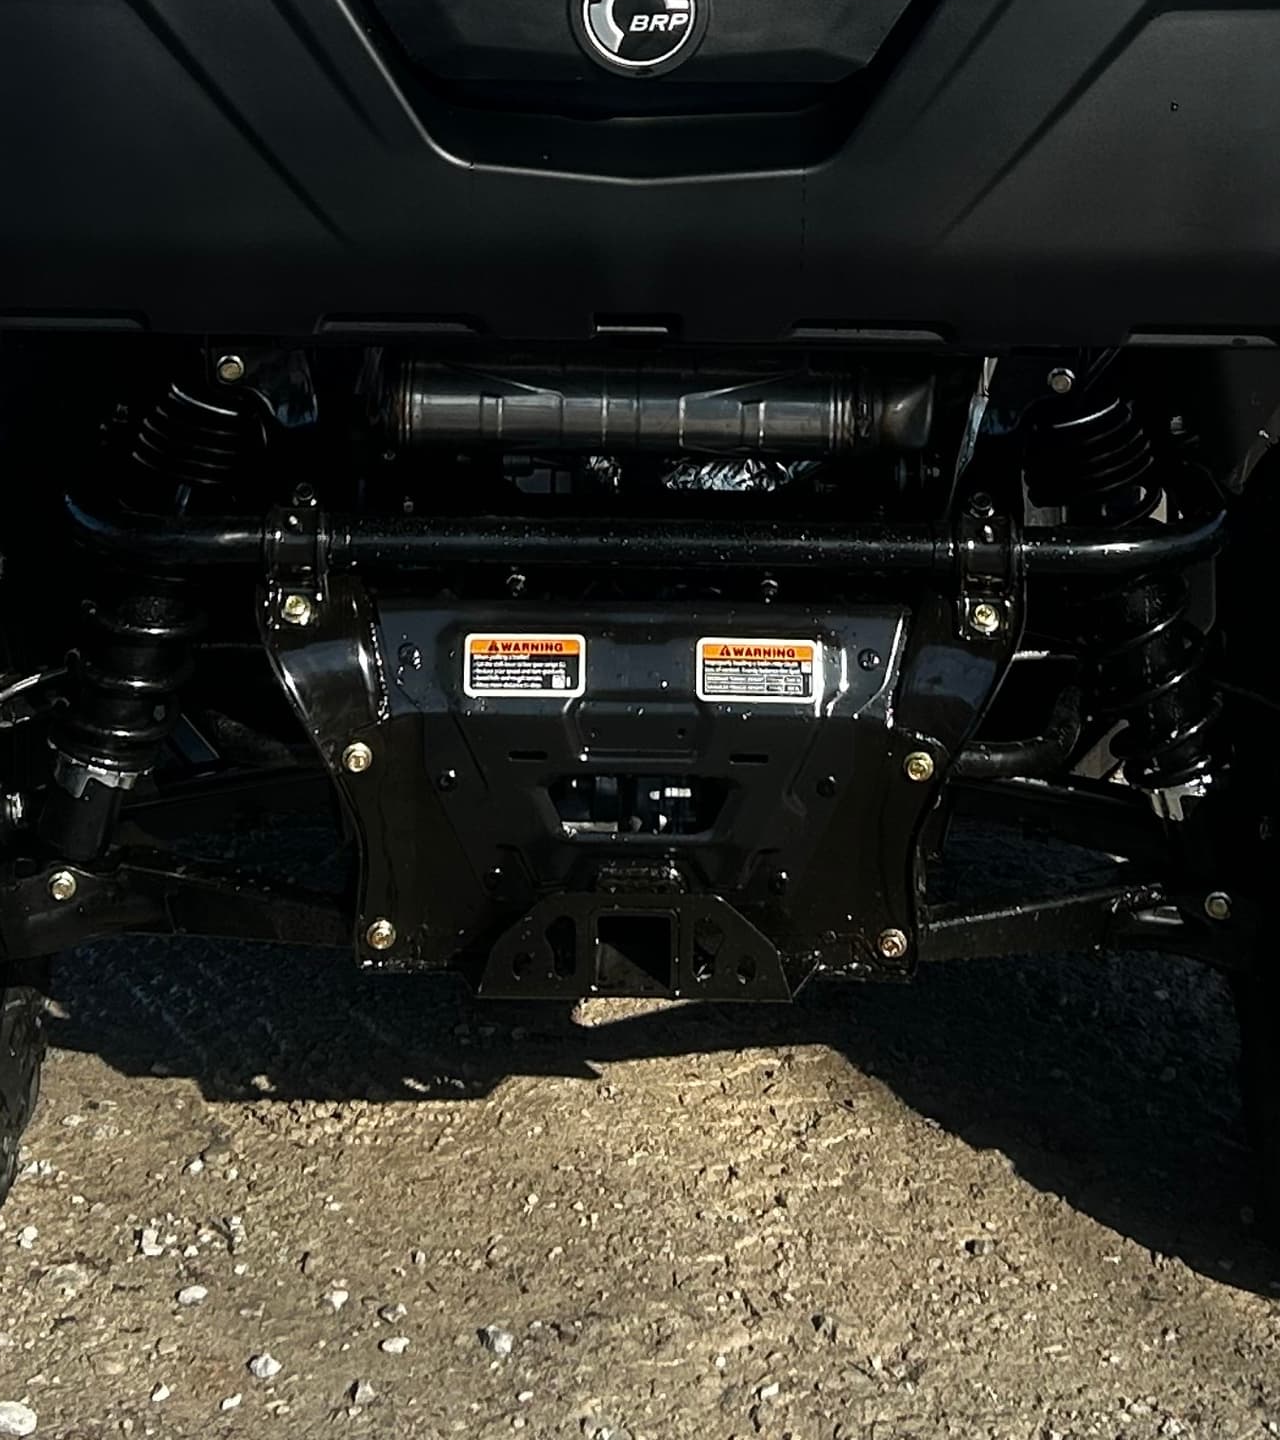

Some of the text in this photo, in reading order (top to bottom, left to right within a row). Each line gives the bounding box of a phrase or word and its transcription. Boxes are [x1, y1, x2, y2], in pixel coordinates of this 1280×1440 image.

[629, 13, 689, 32] BRP
[501, 642, 564, 653] WARNING
[733, 646, 796, 658] WARNING
